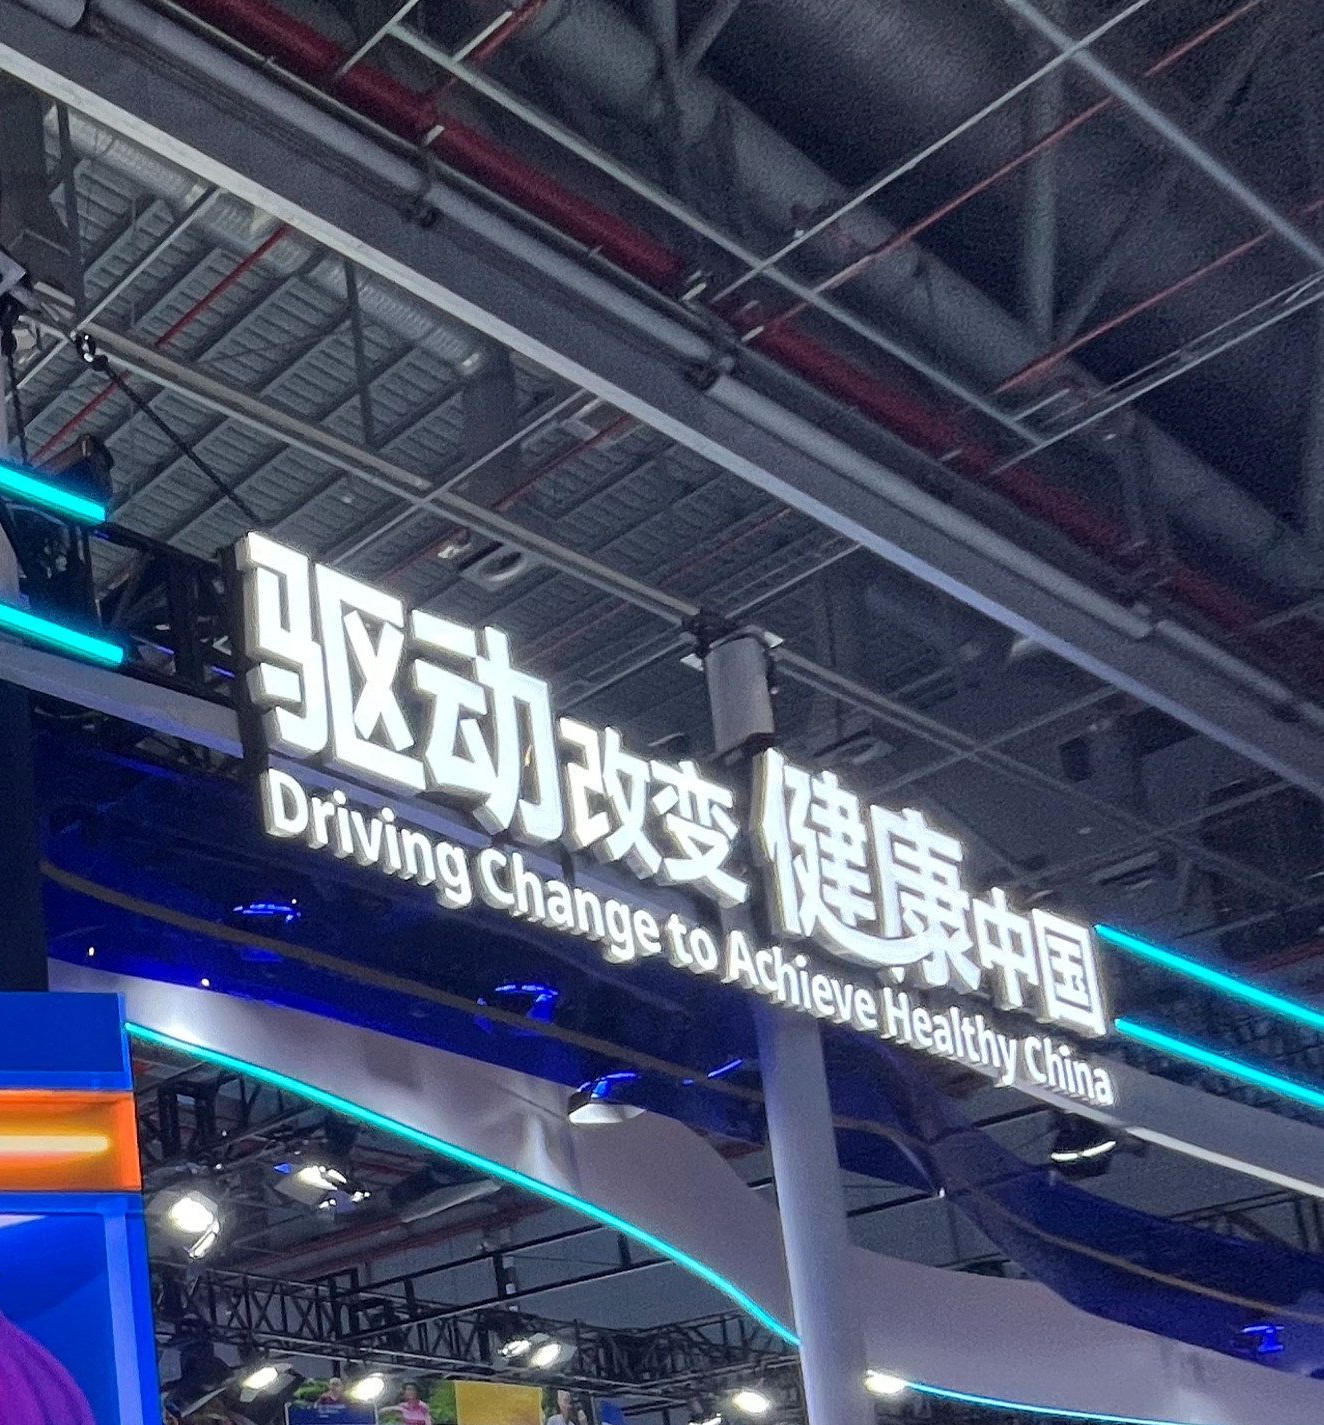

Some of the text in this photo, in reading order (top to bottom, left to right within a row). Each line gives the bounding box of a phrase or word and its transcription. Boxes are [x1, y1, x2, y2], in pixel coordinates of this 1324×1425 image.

[244, 531, 1109, 1037] 驱动改变 健康中国
[265, 767, 1115, 1107] Driving Change to Achieve Healthy China
